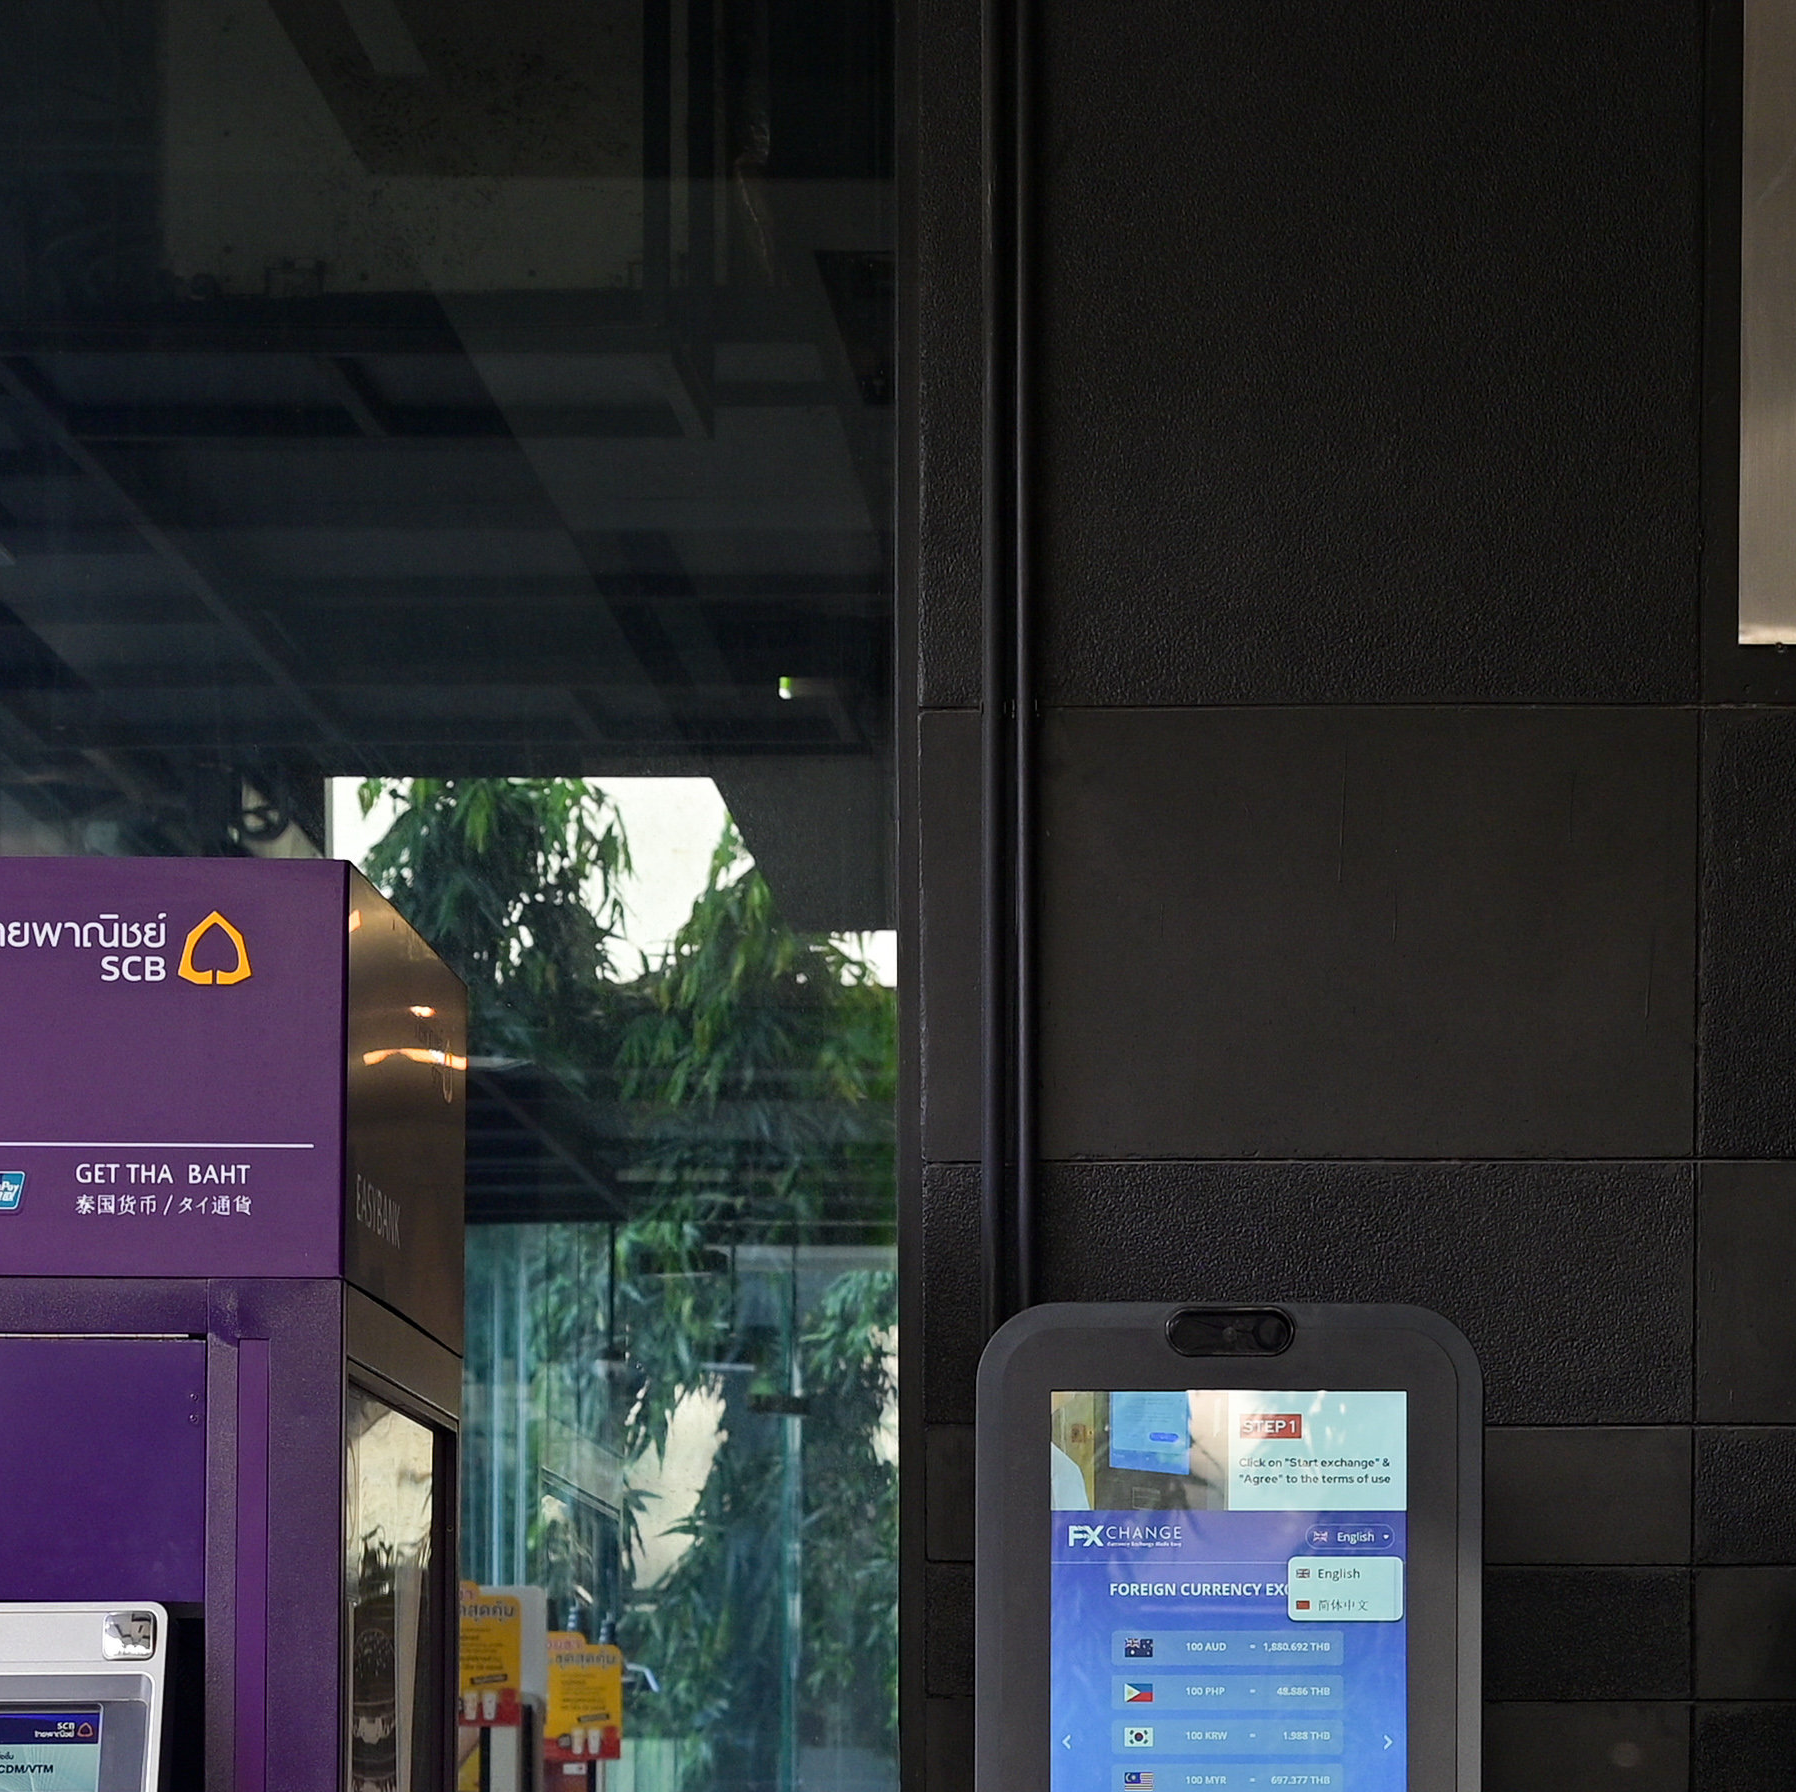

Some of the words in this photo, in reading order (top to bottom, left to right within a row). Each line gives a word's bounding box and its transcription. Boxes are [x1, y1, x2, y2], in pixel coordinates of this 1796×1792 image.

[100, 956, 167, 982] SCB
[75, 1164, 120, 1185] GET
[125, 1164, 173, 1186] THA
[188, 1164, 250, 1186] BAHT
[75, 1194, 157, 1216] 泰国货币
[1243, 1420, 1286, 1433] STEP
[1290, 1420, 1296, 1433] 1
[1239, 1458, 1266, 1467] Click
[1285, 1458, 1318, 1467] "Start
[1321, 1458, 1380, 1469] exchange"
[1382, 1458, 1390, 1467] &
[1239, 1474, 1283, 1485] "Agree"
[1286, 1475, 1297, 1483] to
[1301, 1474, 1319, 1483] the
[1322, 1475, 1354, 1483] terms
[1357, 1474, 1369, 1483] of
[1337, 1531, 1375, 1545] English
[1318, 1568, 1360, 1580] English
[1110, 1584, 1175, 1596] FOREIGN
[1181, 1584, 1262, 1596] CURRENCY
[1186, 1643, 1203, 1651] 100
[1205, 1643, 1227, 1651] AUD
[1310, 1643, 1330, 1651] THB
[1186, 1687, 1203, 1696] 100
[1206, 1687, 1225, 1696] PHP
[1310, 1687, 1330, 1696] THB
[1186, 1731, 1203, 1740] 100
[1205, 1731, 1227, 1740] KRW
[1310, 1731, 1330, 1740] THB
[1186, 1776, 1203, 1784] 100
[1205, 1776, 1227, 1784] MYR
[1310, 1776, 1330, 1784] THB
